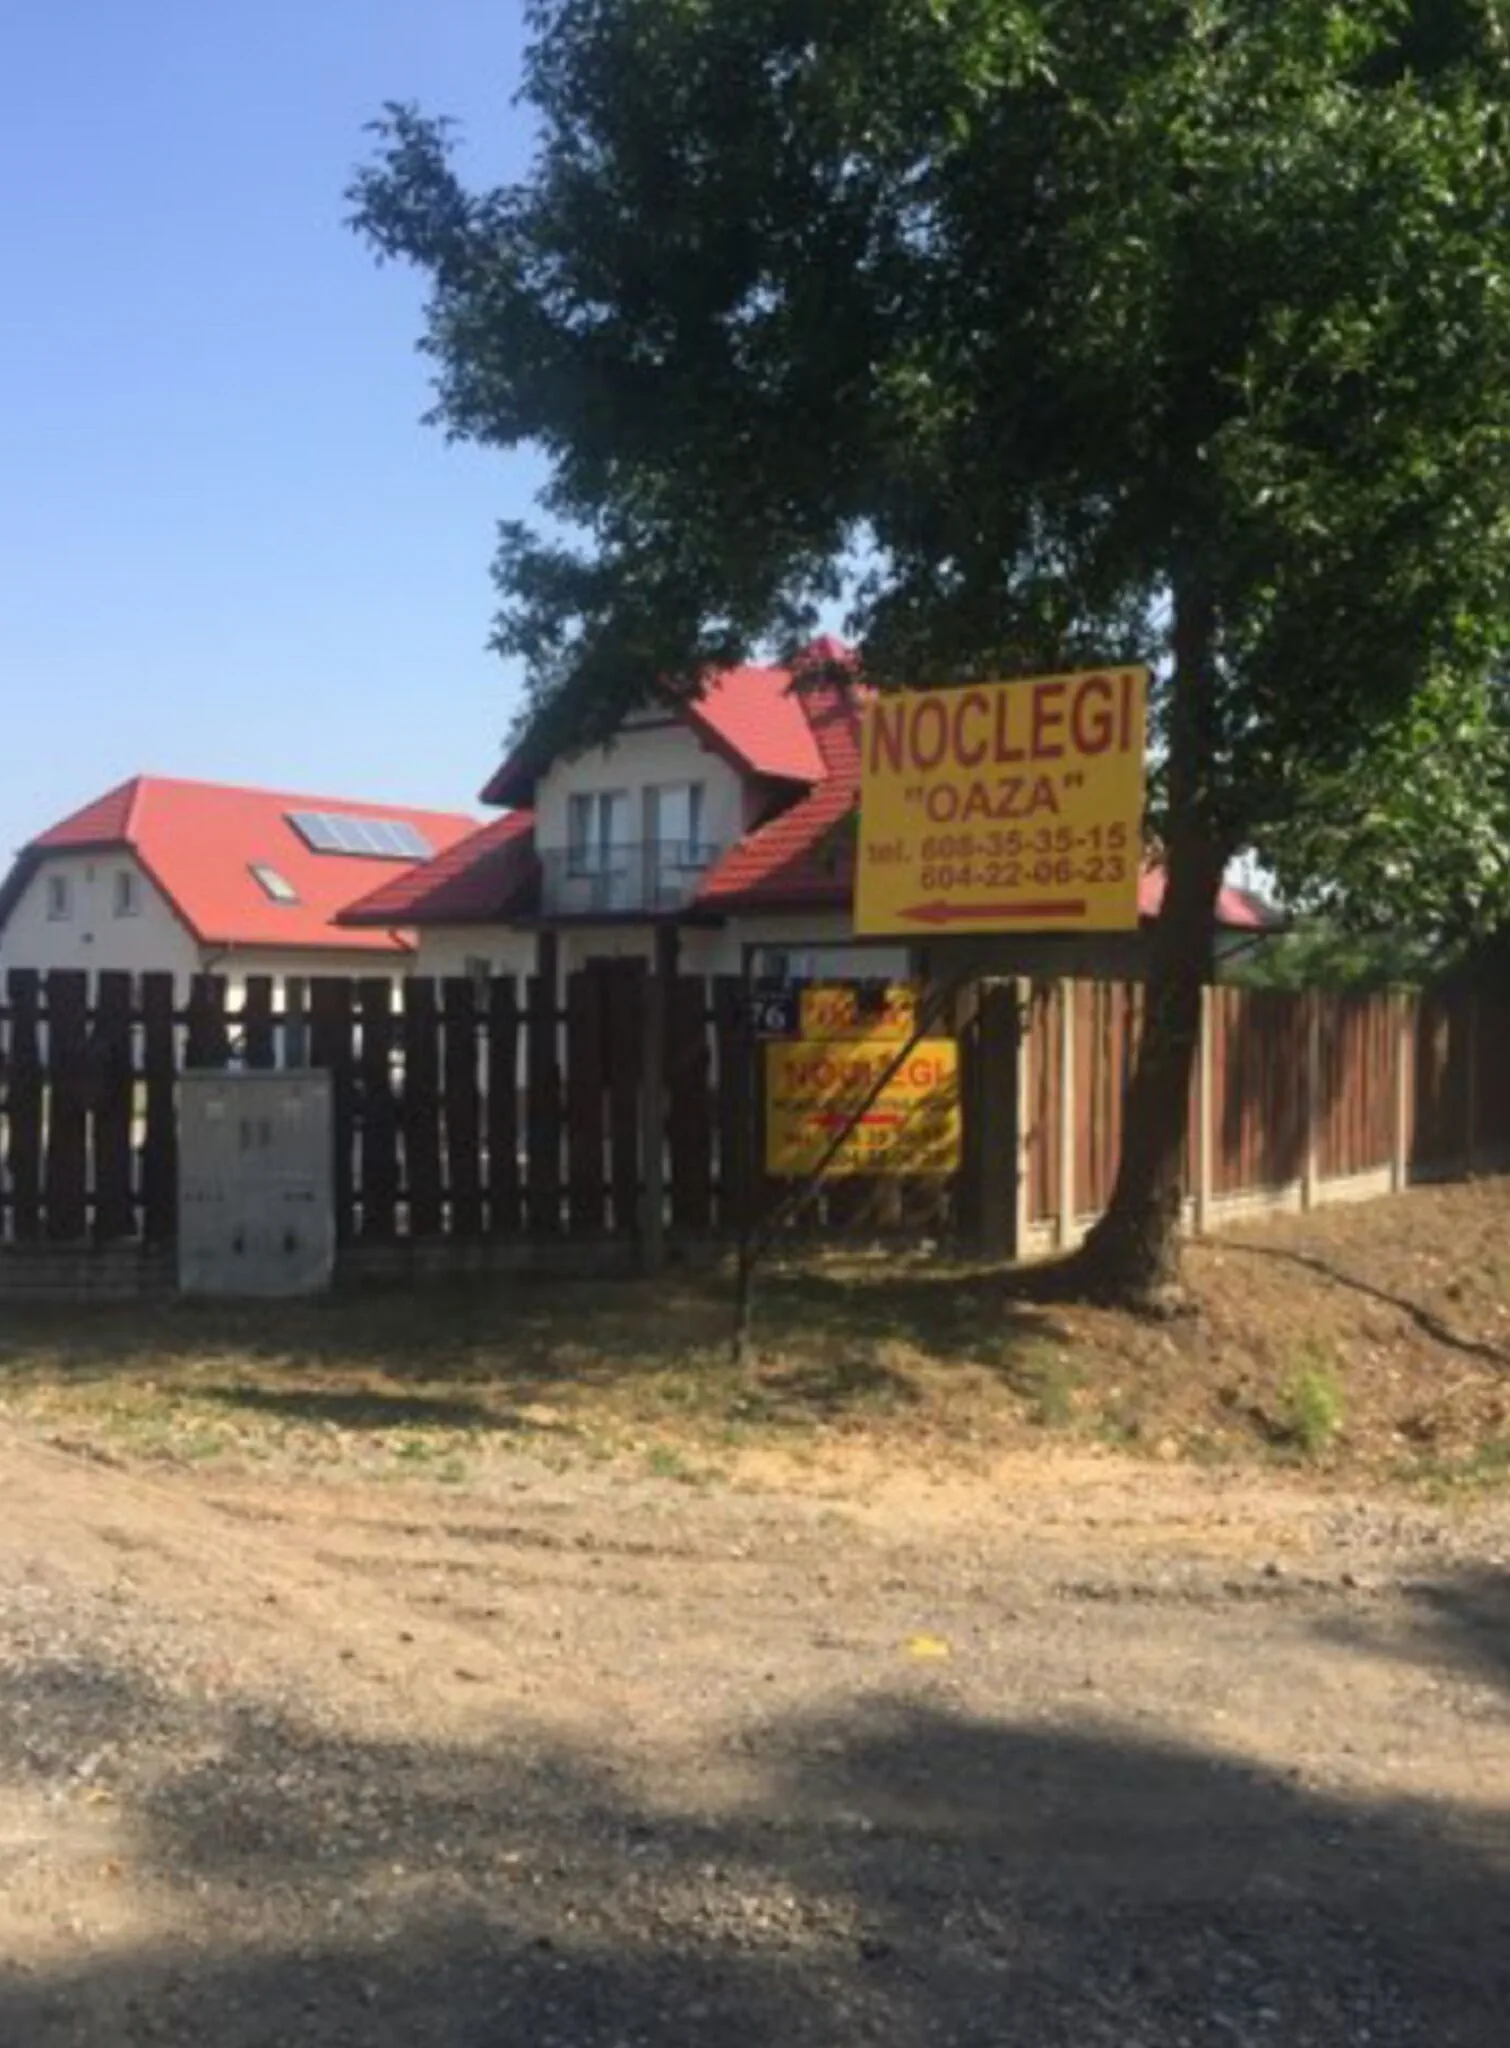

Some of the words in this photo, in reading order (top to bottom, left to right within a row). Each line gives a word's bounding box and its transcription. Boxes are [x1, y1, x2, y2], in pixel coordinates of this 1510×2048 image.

[869, 674, 1134, 775] NOCLEGI
[905, 771, 1084, 822] "OAZA"
[785, 1058, 944, 1089] NOGI
